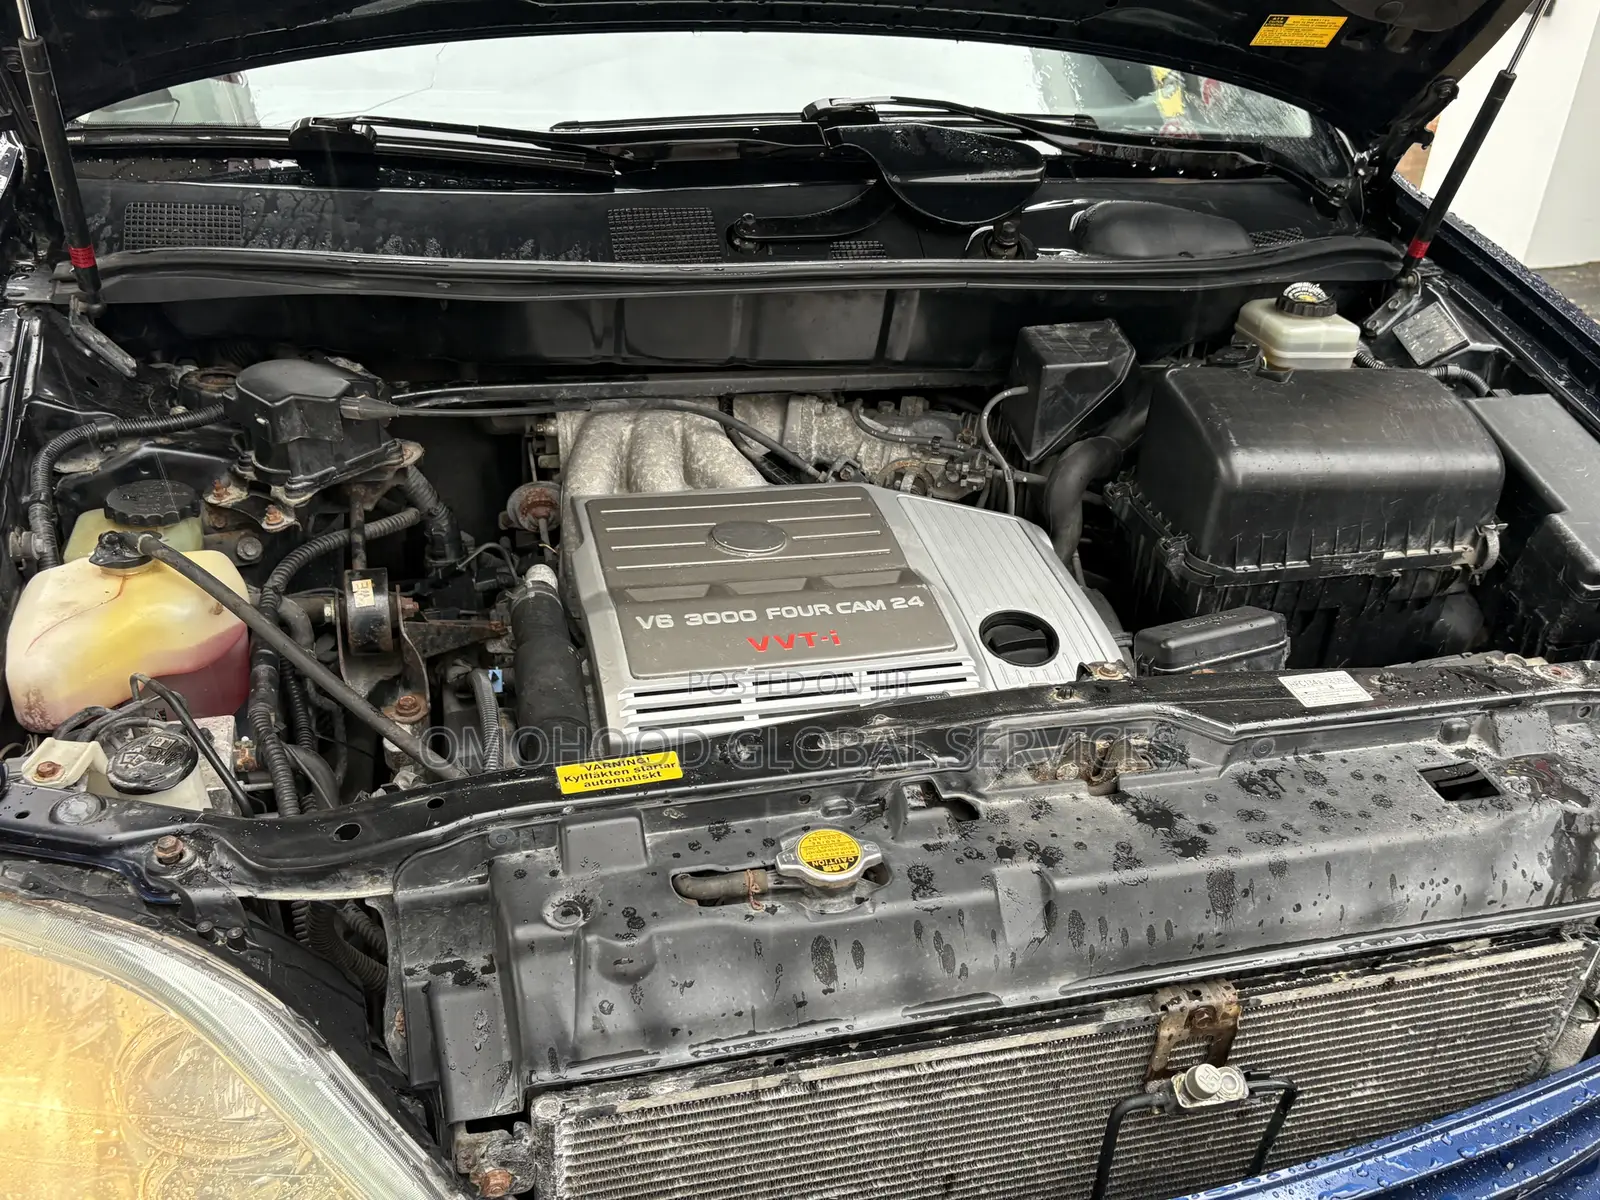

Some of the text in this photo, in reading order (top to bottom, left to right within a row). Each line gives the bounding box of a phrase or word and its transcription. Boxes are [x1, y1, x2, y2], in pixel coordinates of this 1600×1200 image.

[635, 595, 925, 629] V6 3000 FOUR CAM 24
[747, 629, 841, 652] VVT-i
[563, 761, 677, 783] Kylfläkten startar
[583, 756, 650, 771] VARNING!
[583, 770, 662, 788] automatiskt
[812, 857, 855, 867] CAUTION
